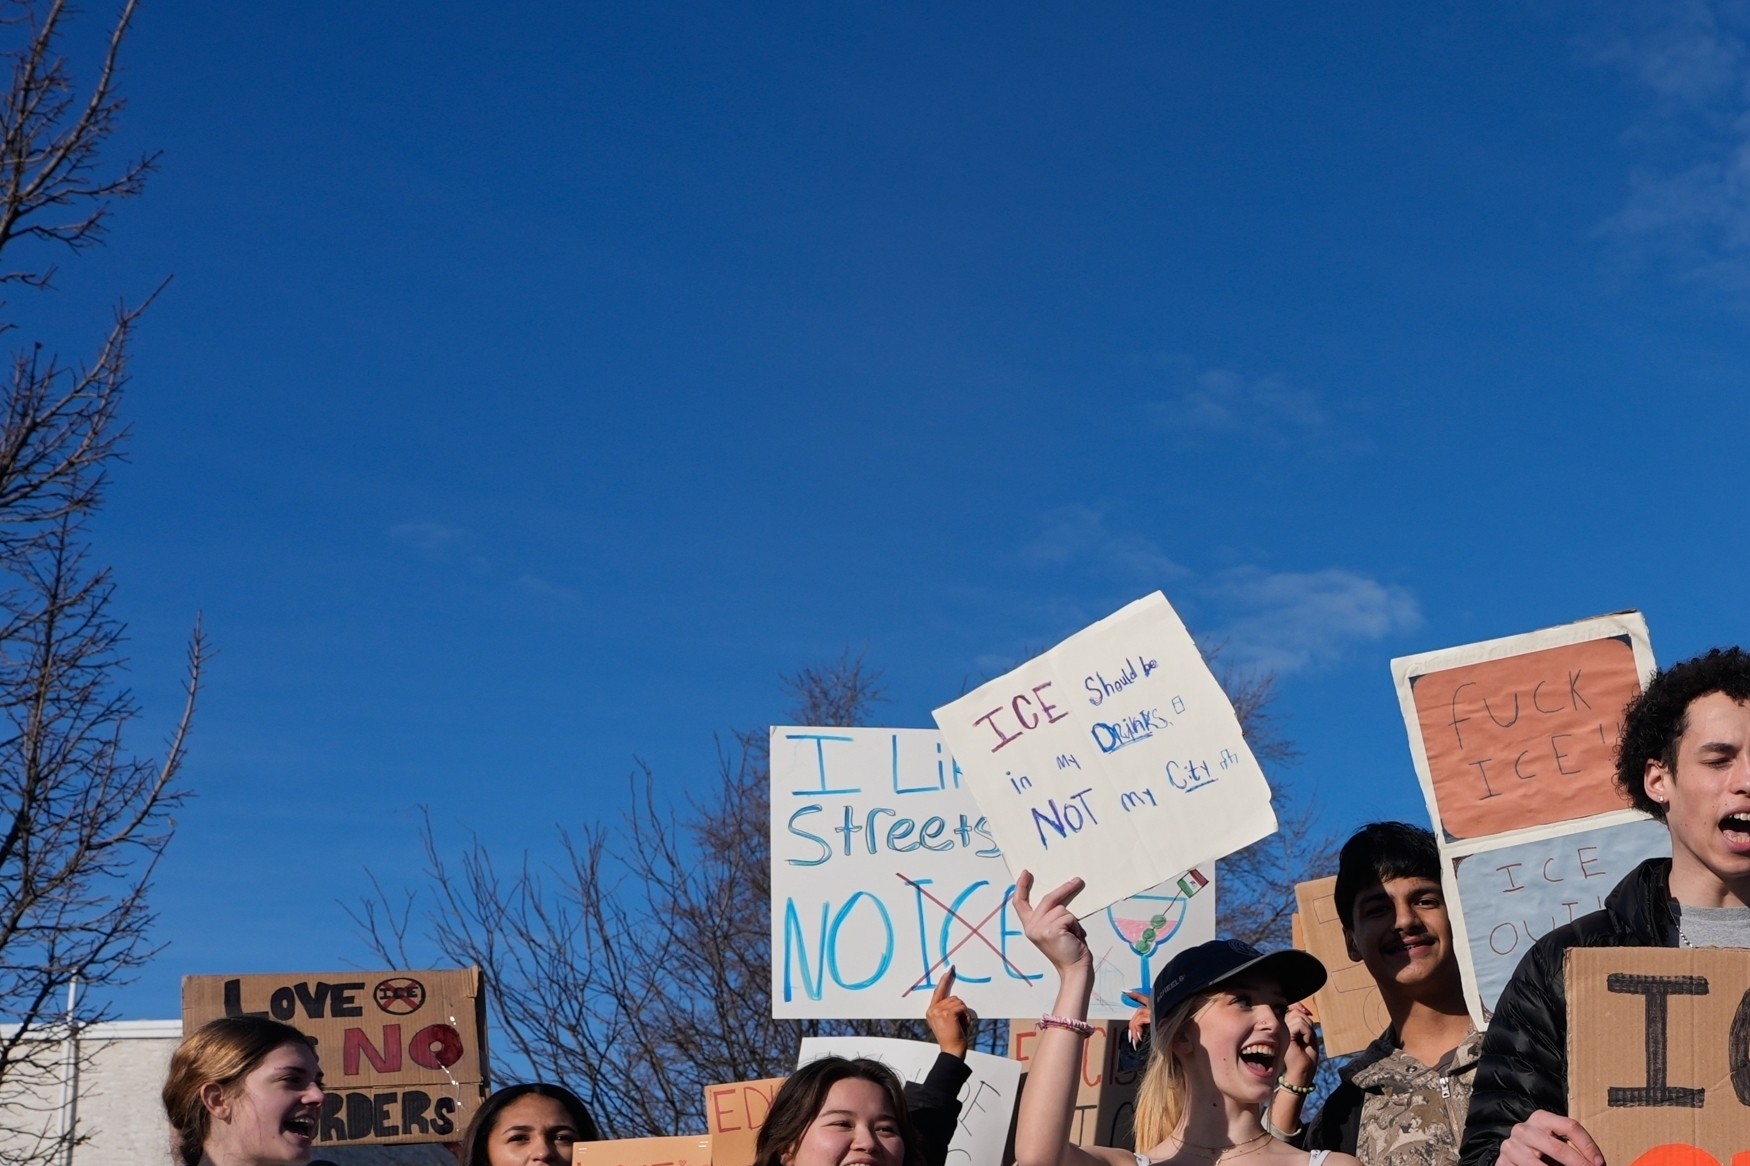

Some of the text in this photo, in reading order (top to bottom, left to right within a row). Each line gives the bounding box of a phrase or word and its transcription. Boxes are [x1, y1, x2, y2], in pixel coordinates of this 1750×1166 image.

[972, 681, 1069, 753] ICE
[1085, 657, 1138, 707] Should
[785, 735, 862, 796] I
[1005, 771, 1032, 795] in
[784, 804, 1001, 866] Streets
[1031, 788, 1098, 850] NOT
[1496, 847, 1606, 893] ICE
[784, 879, 1043, 1002] NO ICE
[224, 978, 365, 1021] LOVE
[343, 1023, 464, 1076] NO
[312, 1090, 455, 1142] RDERS
